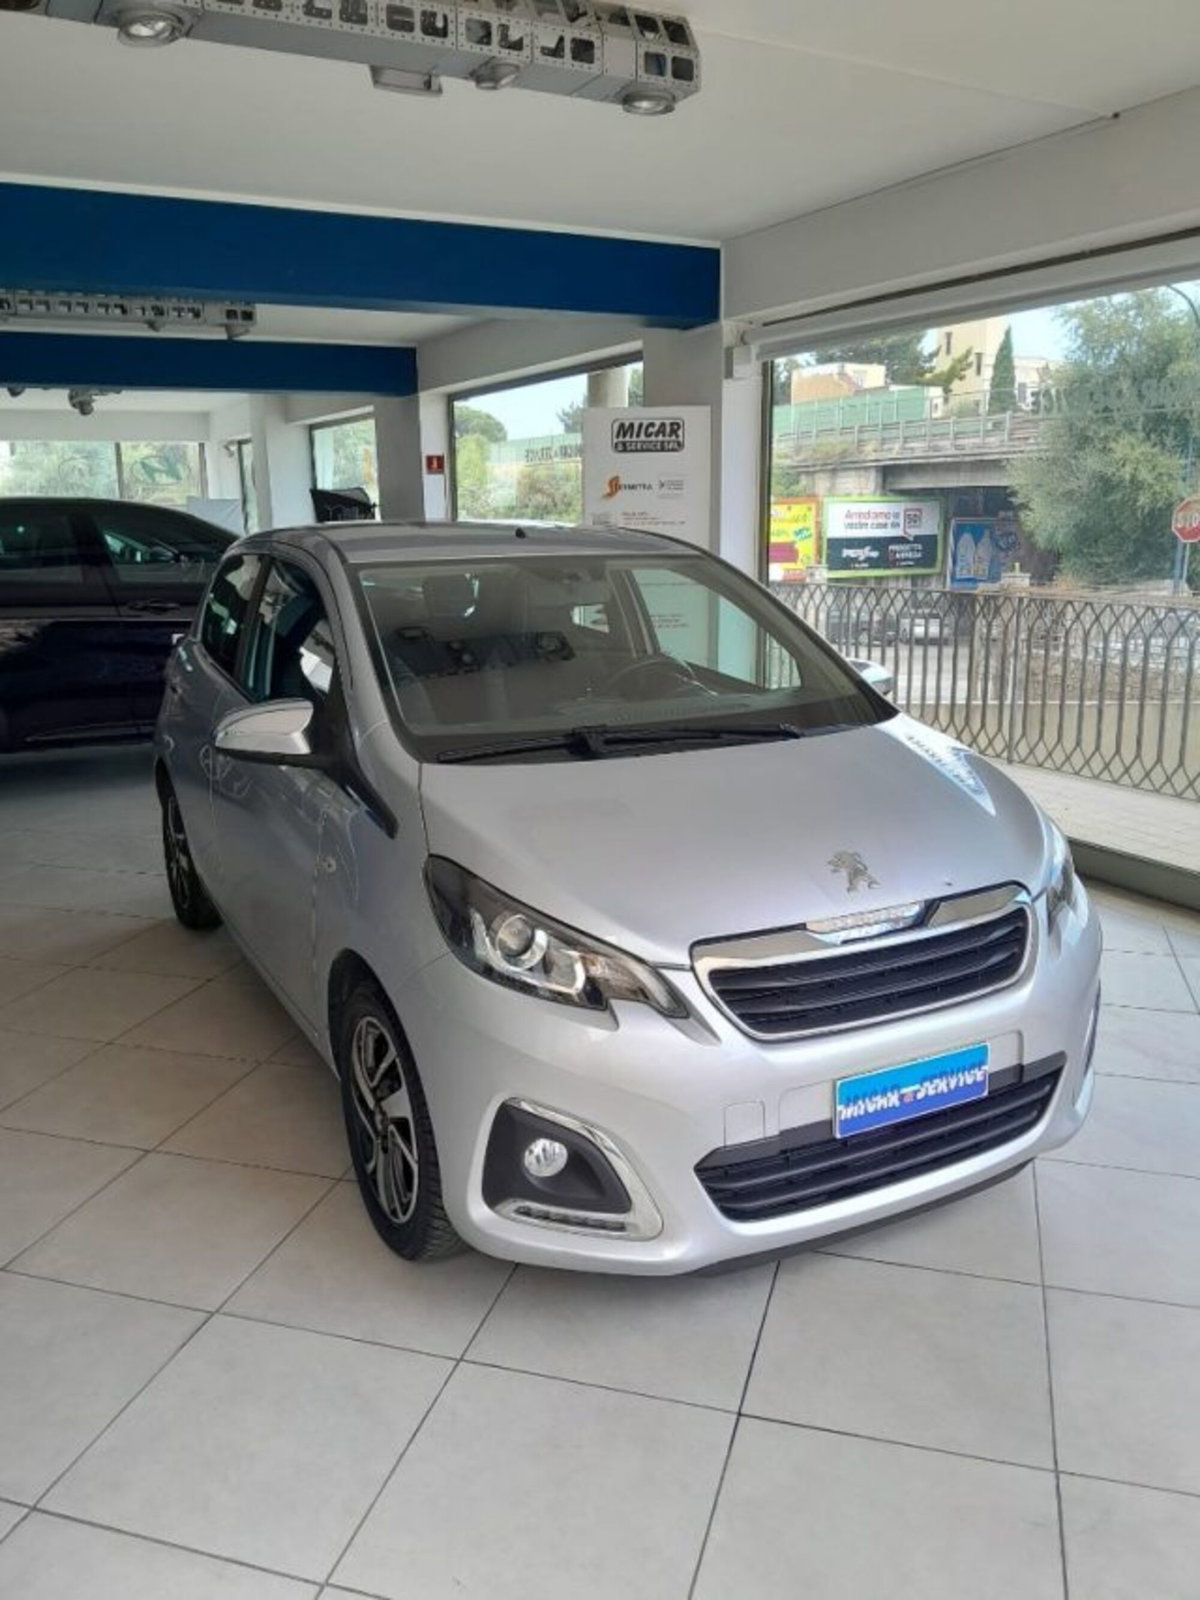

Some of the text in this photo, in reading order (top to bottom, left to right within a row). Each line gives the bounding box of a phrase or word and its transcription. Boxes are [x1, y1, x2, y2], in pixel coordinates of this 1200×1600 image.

[615, 421, 681, 439] MICAR
[626, 442, 661, 451] SERVICE
[1177, 510, 1200, 528] STO
[916, 1061, 988, 1100] SERVICE
